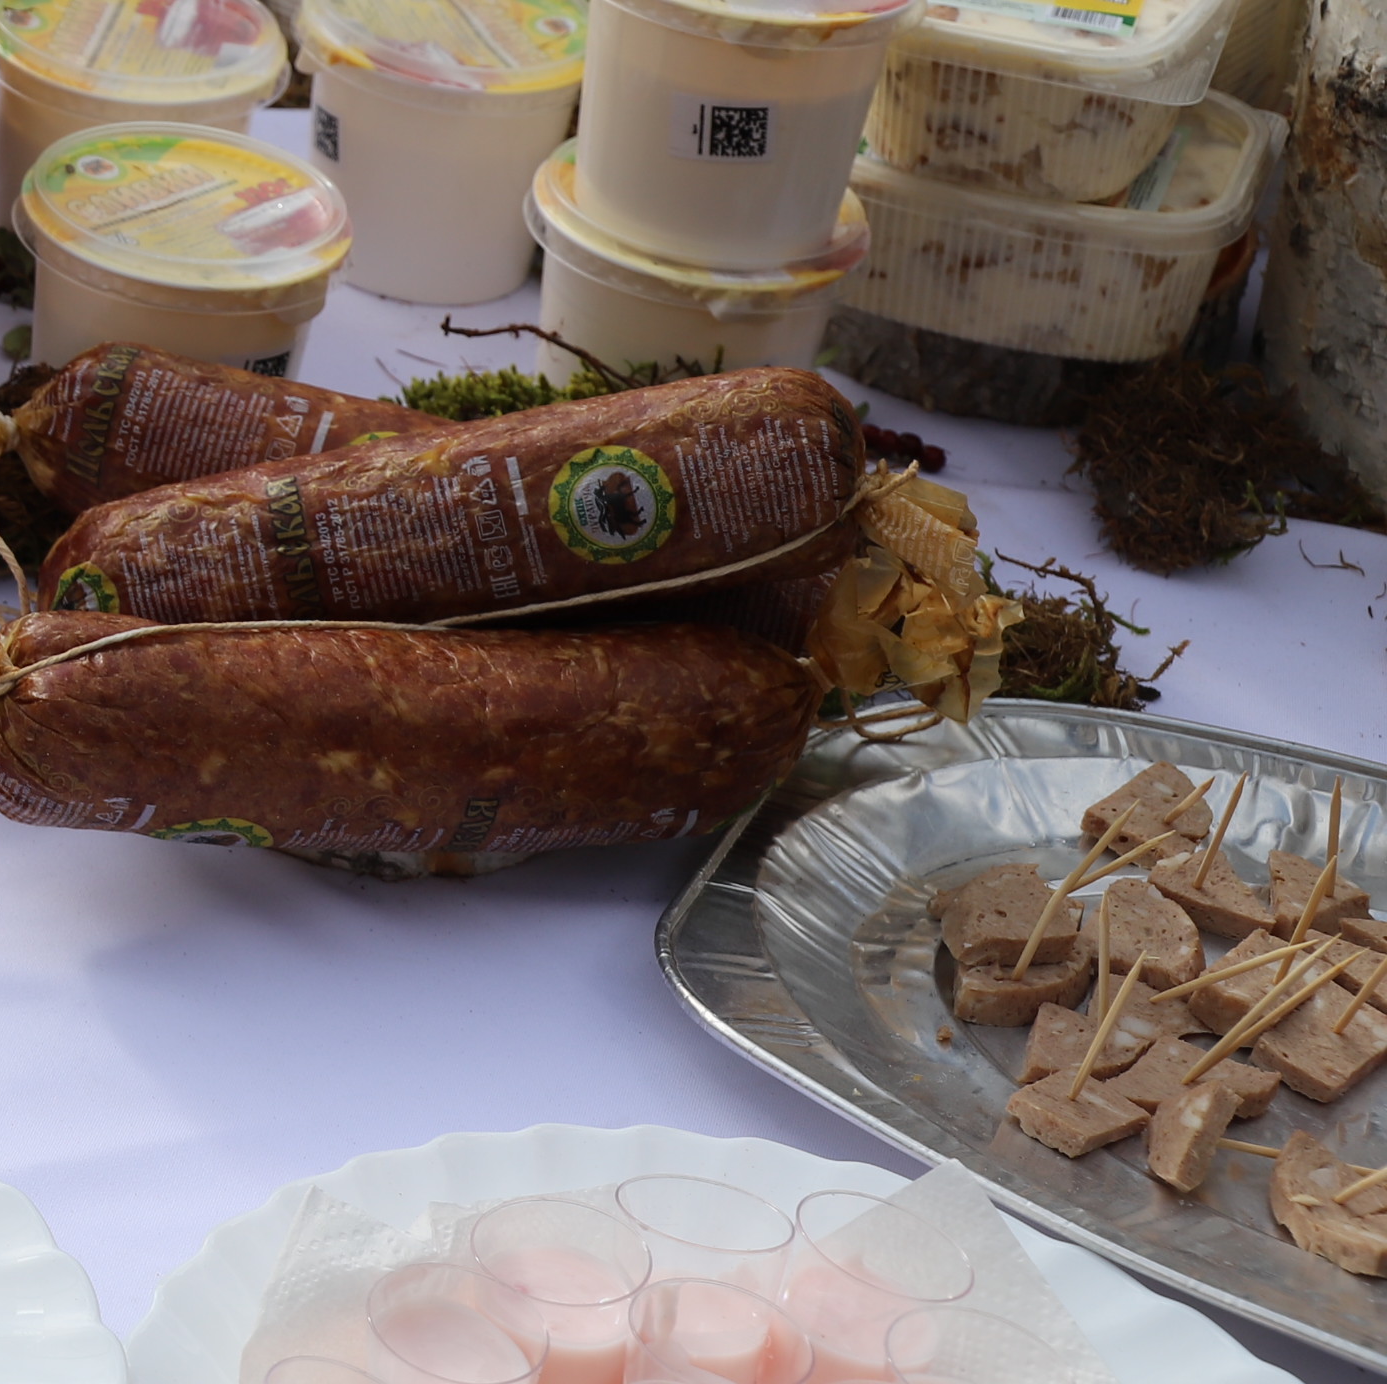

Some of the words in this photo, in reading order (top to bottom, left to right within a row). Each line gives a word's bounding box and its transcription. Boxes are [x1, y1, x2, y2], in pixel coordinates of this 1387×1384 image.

[123, 369, 147, 418] 034/2013
[118, 417, 131, 435] ТС
[125, 435, 140, 467] ГОСТ
[315, 512, 335, 564] 034/2013
[327, 497, 351, 563] 31785-2012
[328, 566, 340, 585] ТС
[332, 586, 345, 603] ТР
[346, 578, 361, 608] ГОСТ
